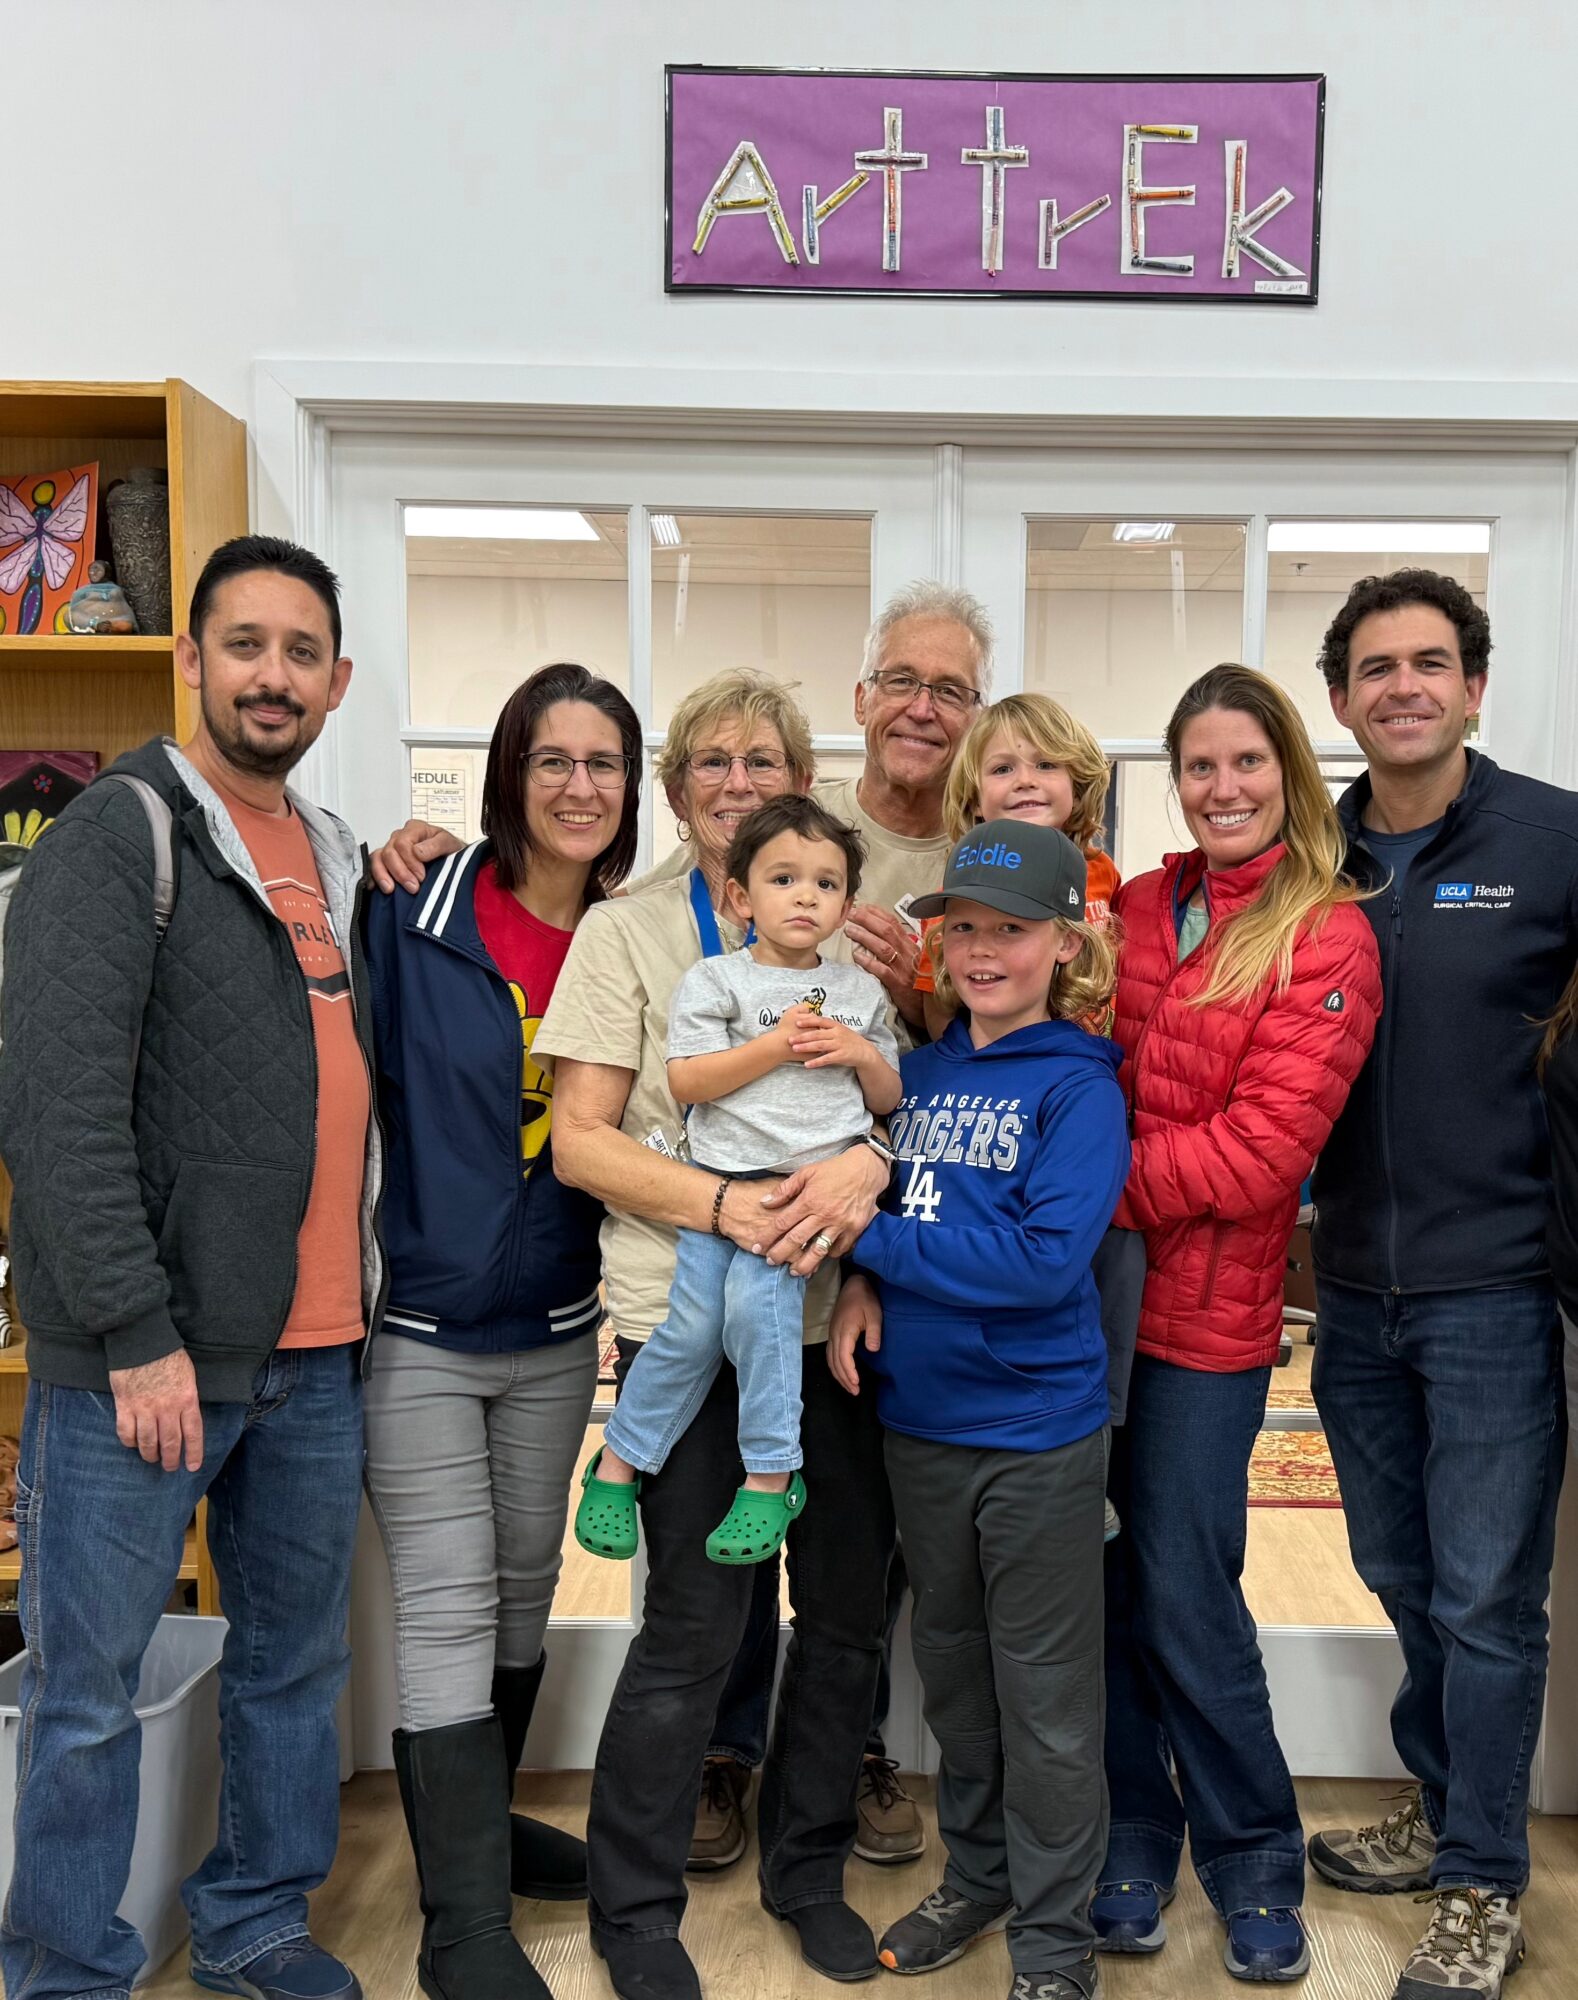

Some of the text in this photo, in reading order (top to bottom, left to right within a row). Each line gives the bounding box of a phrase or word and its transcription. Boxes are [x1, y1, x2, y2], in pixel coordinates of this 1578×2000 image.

[411, 773, 458, 784] HEDULE
[956, 842, 1022, 869] Eddie
[1441, 885, 1514, 897] UCLA Health
[831, 1014, 863, 1026] World
[896, 1094, 1021, 1111] OS ANGELES
[889, 1109, 1023, 1172] ODGERS
[901, 1155, 942, 1221] LA
